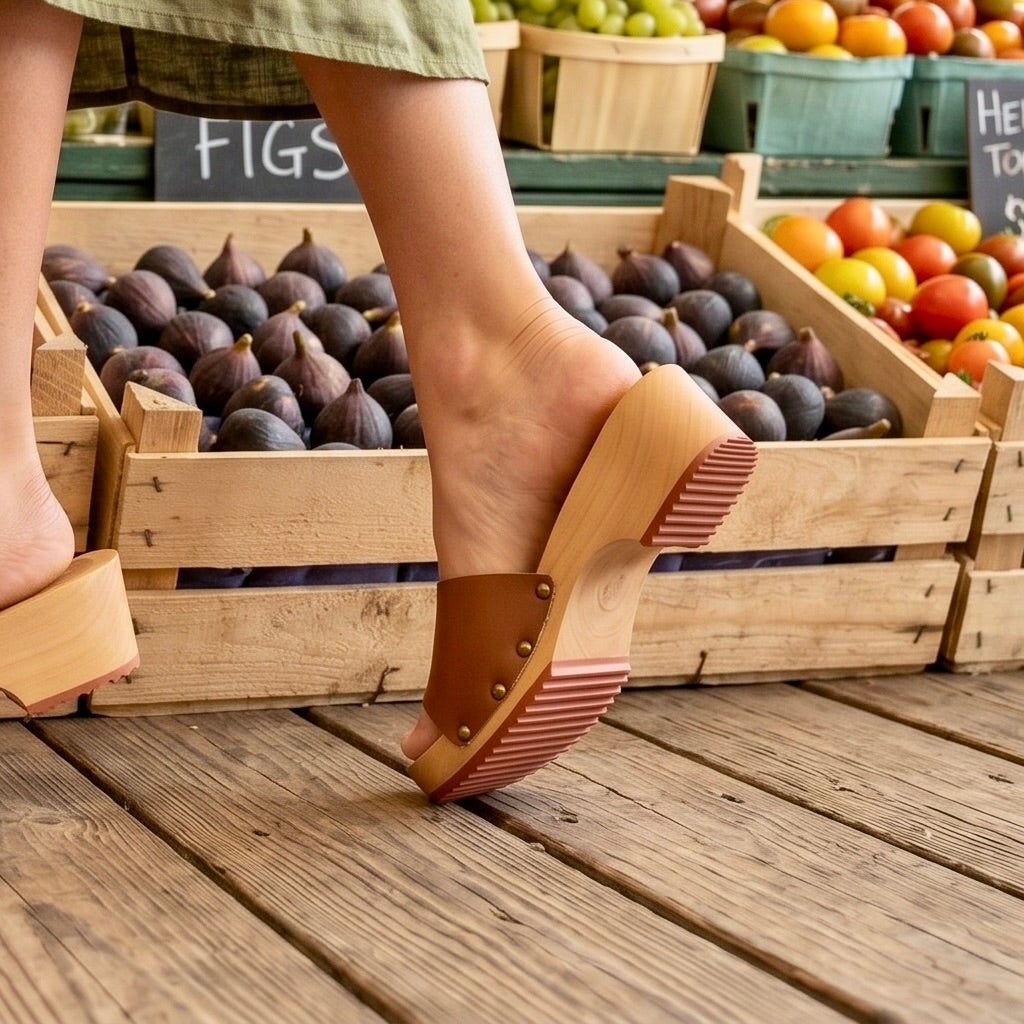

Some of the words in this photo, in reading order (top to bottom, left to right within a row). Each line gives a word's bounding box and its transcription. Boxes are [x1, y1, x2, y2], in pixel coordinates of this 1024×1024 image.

[977, 88, 1024, 136] HE
[195, 118, 350, 180] FIGS
[983, 141, 1024, 178] TO
